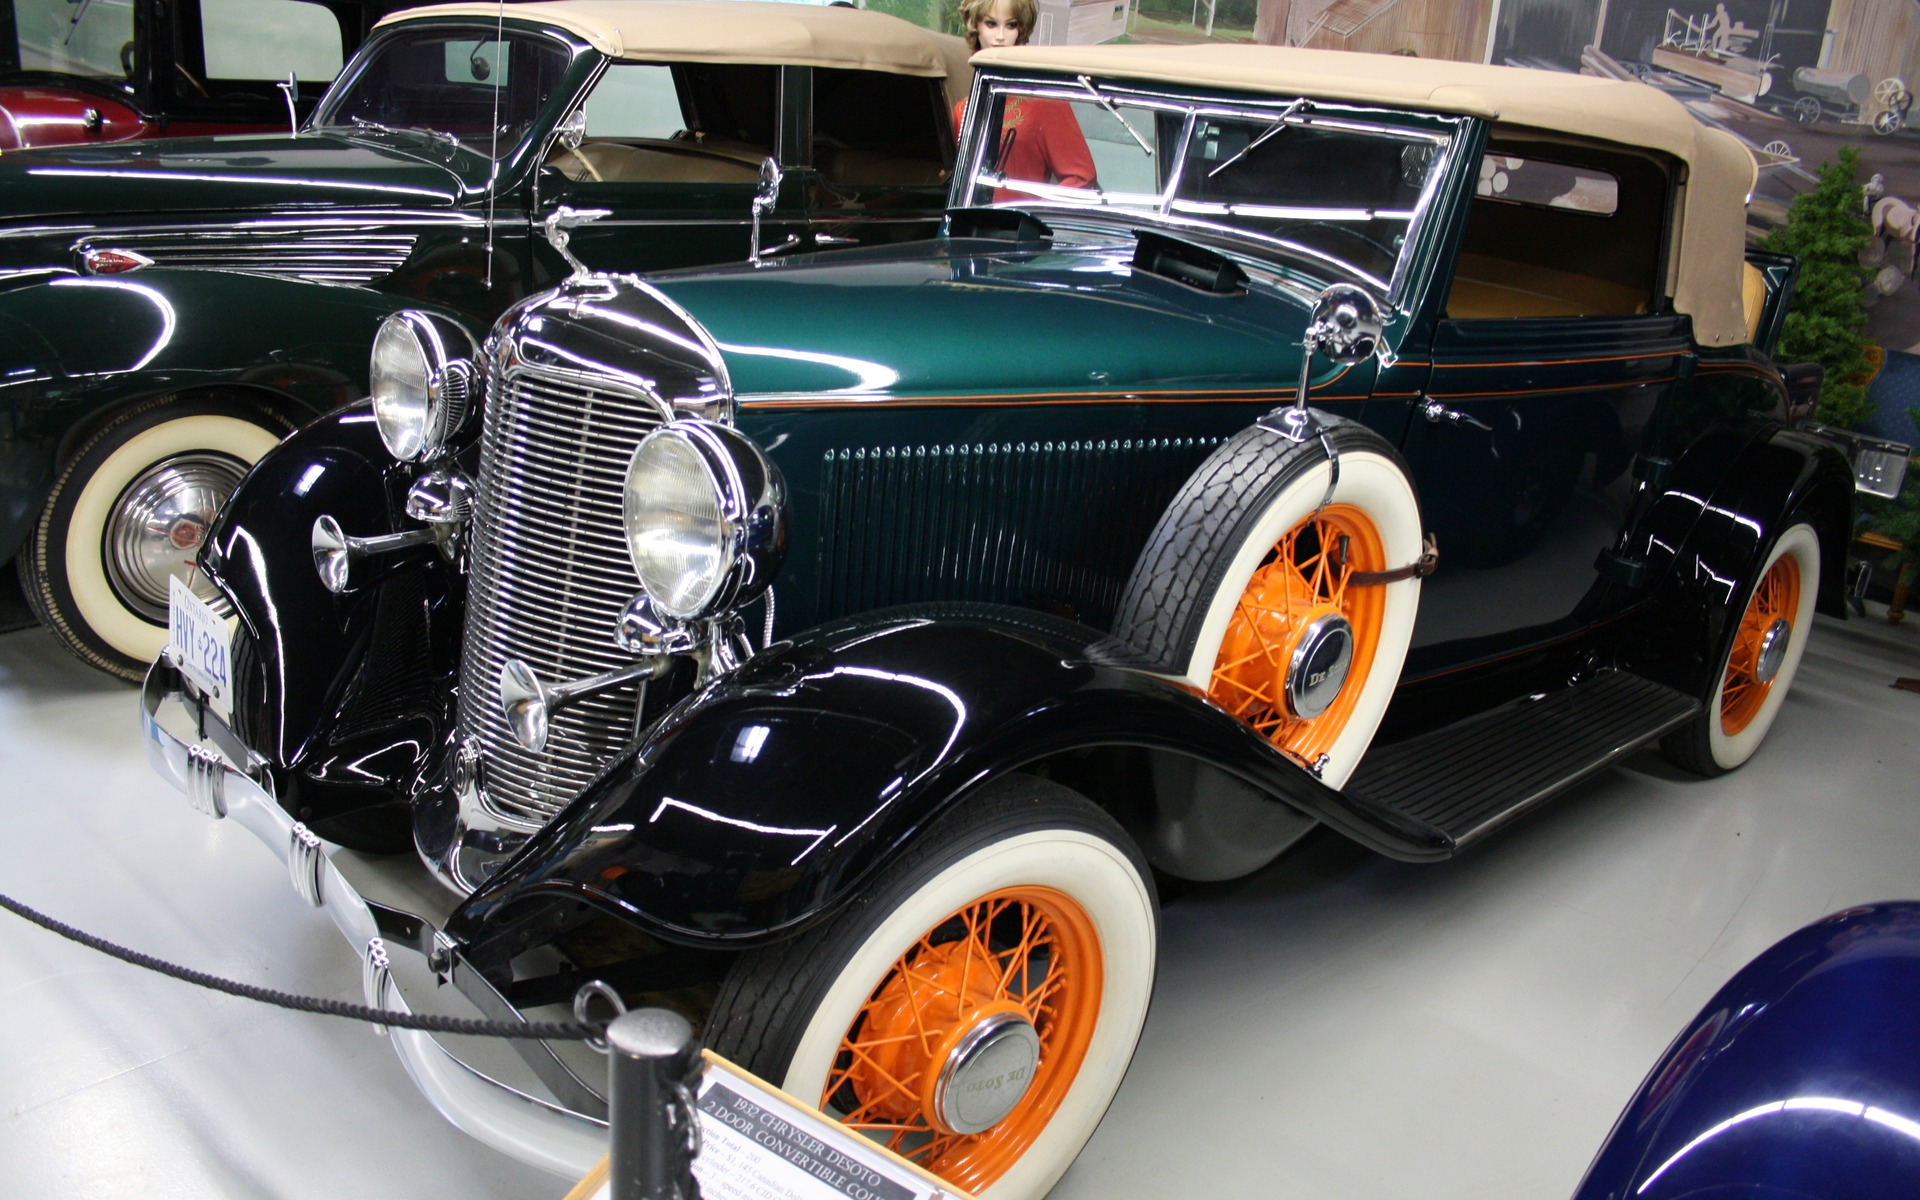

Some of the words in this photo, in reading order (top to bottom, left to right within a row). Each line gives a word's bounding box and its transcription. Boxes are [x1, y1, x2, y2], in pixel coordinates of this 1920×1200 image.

[176, 605, 195, 660] HVY
[203, 631, 227, 688] 224
[704, 1100, 716, 1112] 2
[715, 1106, 754, 1135] DOOR
[755, 1130, 847, 1188] CONVERTIBLE
[733, 1097, 760, 1118] 1932
[759, 1112, 825, 1157] CHRYSLER
[826, 1150, 881, 1187] DESOTO
